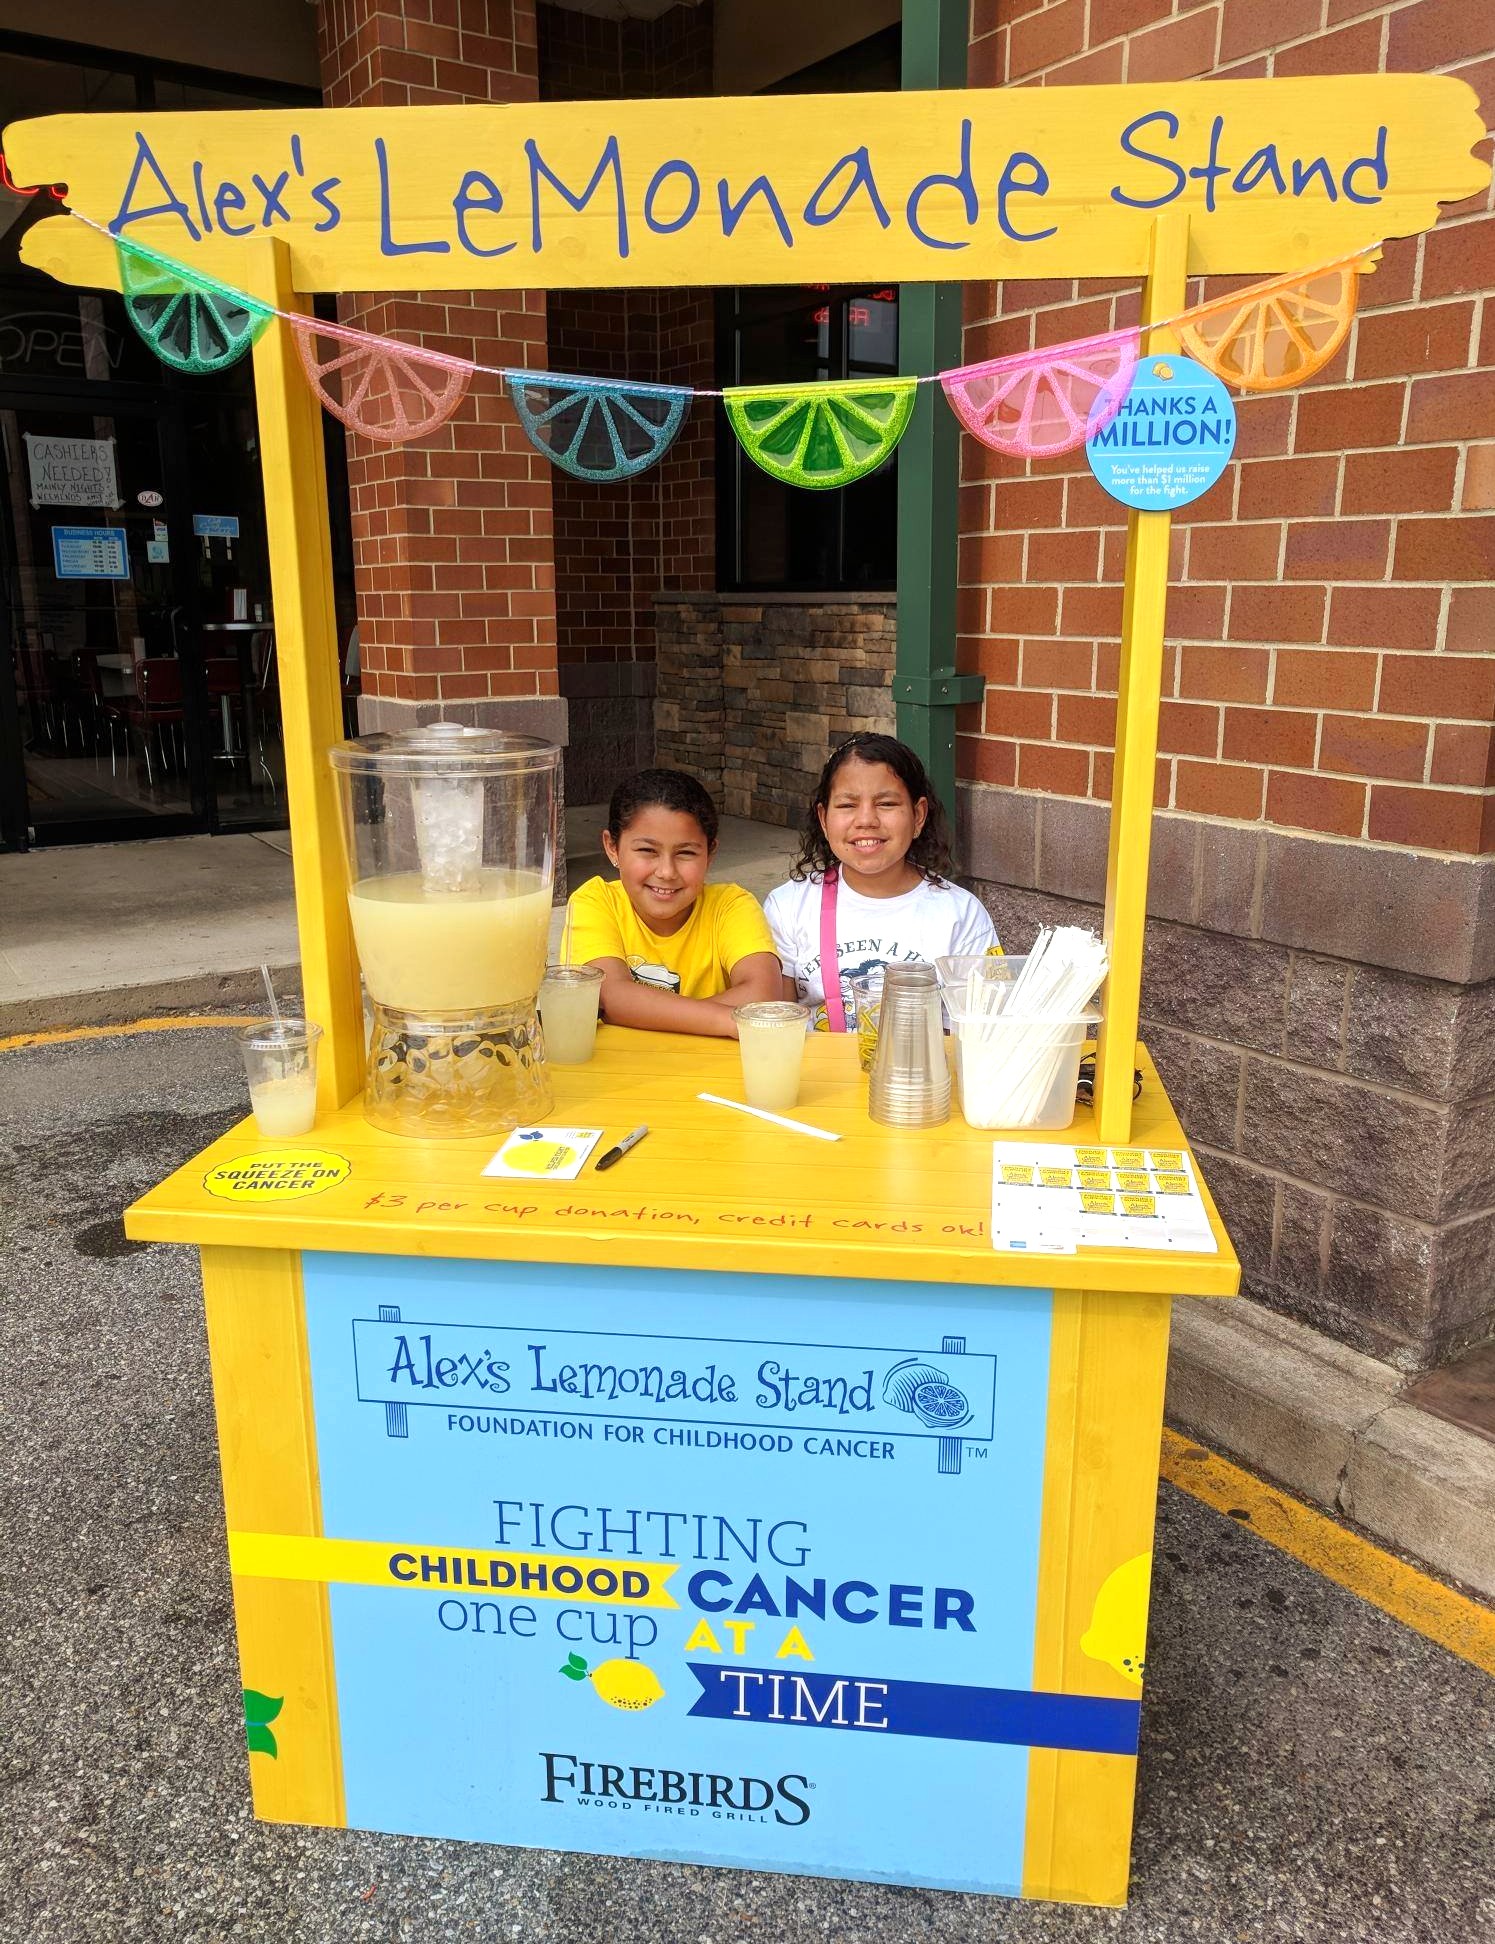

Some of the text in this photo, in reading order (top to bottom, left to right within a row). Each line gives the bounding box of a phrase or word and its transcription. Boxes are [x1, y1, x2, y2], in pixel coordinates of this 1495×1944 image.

[108, 111, 1388, 259] Alex's LeMonade Stand
[0, 325, 124, 368] OPEN
[1105, 395, 1218, 416] THANKS A
[1092, 419, 1232, 447] MILLION!
[33, 443, 108, 463] CASHIERS
[1111, 465, 1140, 475] You've
[1142, 464, 1174, 478] helped
[1188, 463, 1210, 473] raise
[1112, 474, 1206, 485] more than $1 million
[1130, 485, 1188, 498] for the fight.
[836, 938, 882, 958] SEEN
[886, 942, 899, 956] A
[214, 1169, 340, 1180] SQUEEZE ON
[232, 1180, 315, 1190] CANCER
[364, 1192, 408, 1209] $3
[416, 1199, 468, 1214] per
[484, 1202, 538, 1218] cup
[555, 1206, 700, 1225] donation,
[718, 1214, 814, 1228] credit
[832, 1219, 923, 1233] cards
[386, 1335, 876, 1414] Alex's Lemonade Stand
[448, 1414, 895, 1459] FOUNDATION FOR CHILDHOOD CANCER
[493, 1500, 811, 1566] FIGHTING
[389, 1553, 977, 1632] CHILDHOOD CANCER
[438, 1600, 815, 1661] one cup AT A
[720, 1670, 888, 1728] TIME
[539, 1752, 811, 1826] FIREBIRDS
[577, 1797, 768, 1823] WOOD FIRED GRILL
